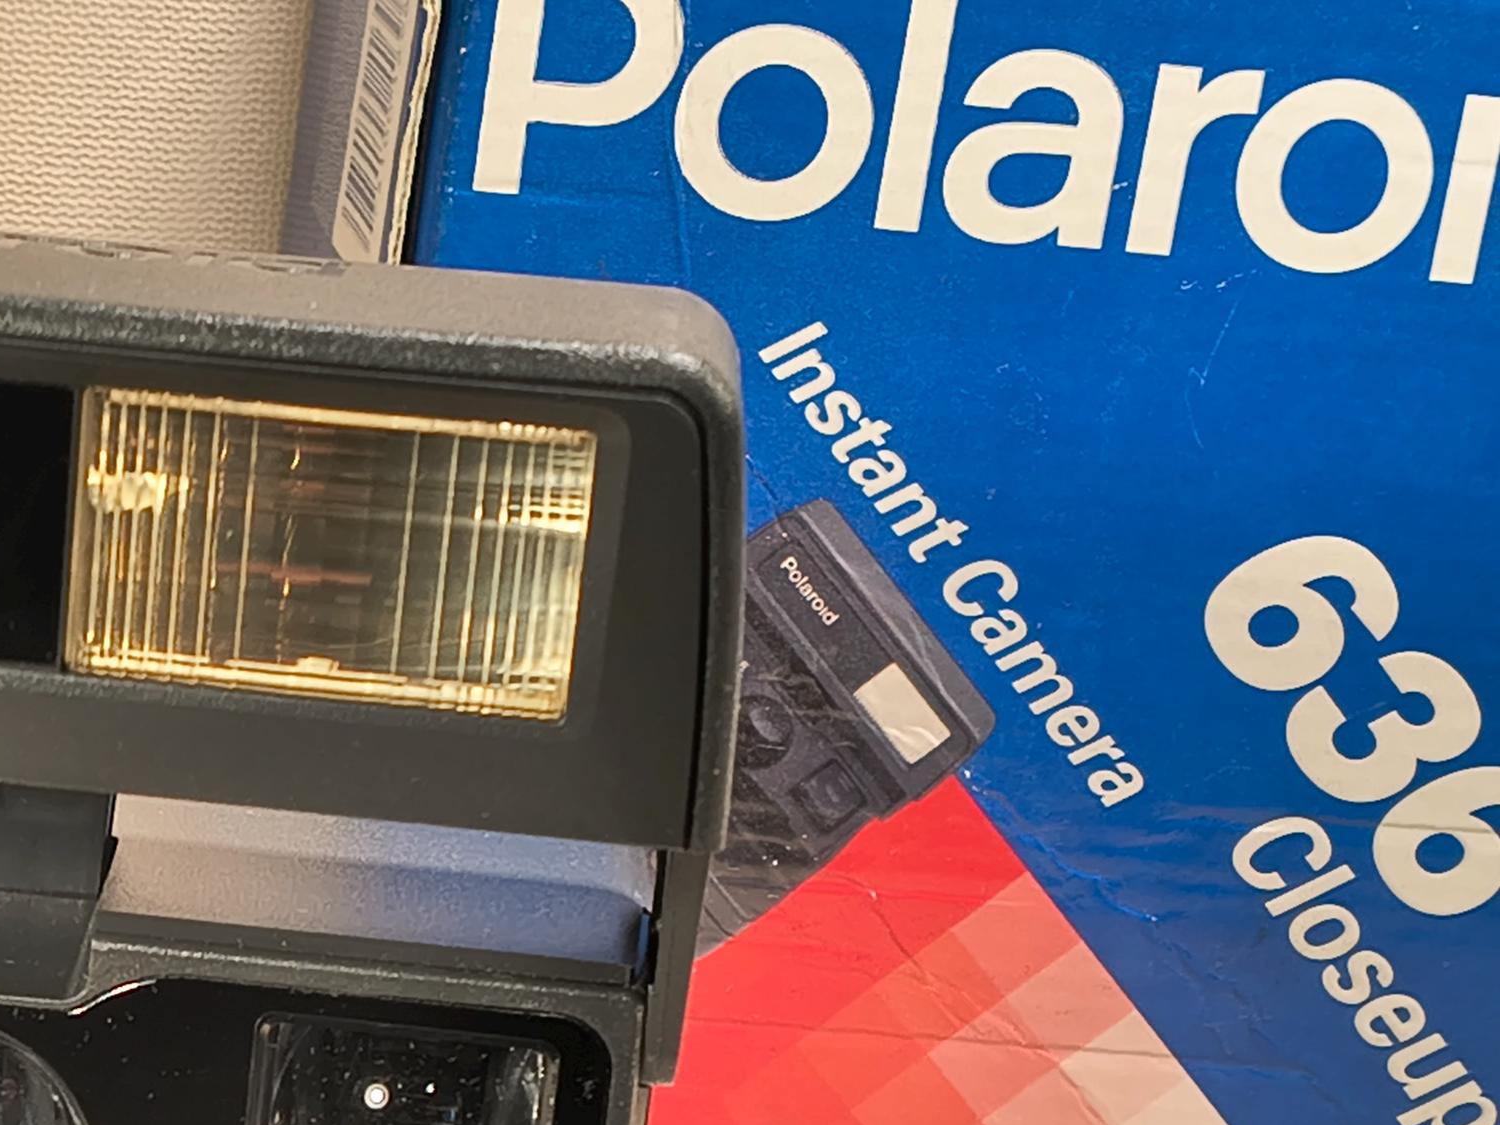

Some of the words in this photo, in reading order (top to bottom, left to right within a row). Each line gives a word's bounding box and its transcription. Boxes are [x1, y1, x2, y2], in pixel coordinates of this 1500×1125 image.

[758, 321, 969, 563] Instant
[942, 559, 1145, 808] Camera
[779, 555, 841, 627] Polaroid
[1204, 535, 1500, 916] 636
